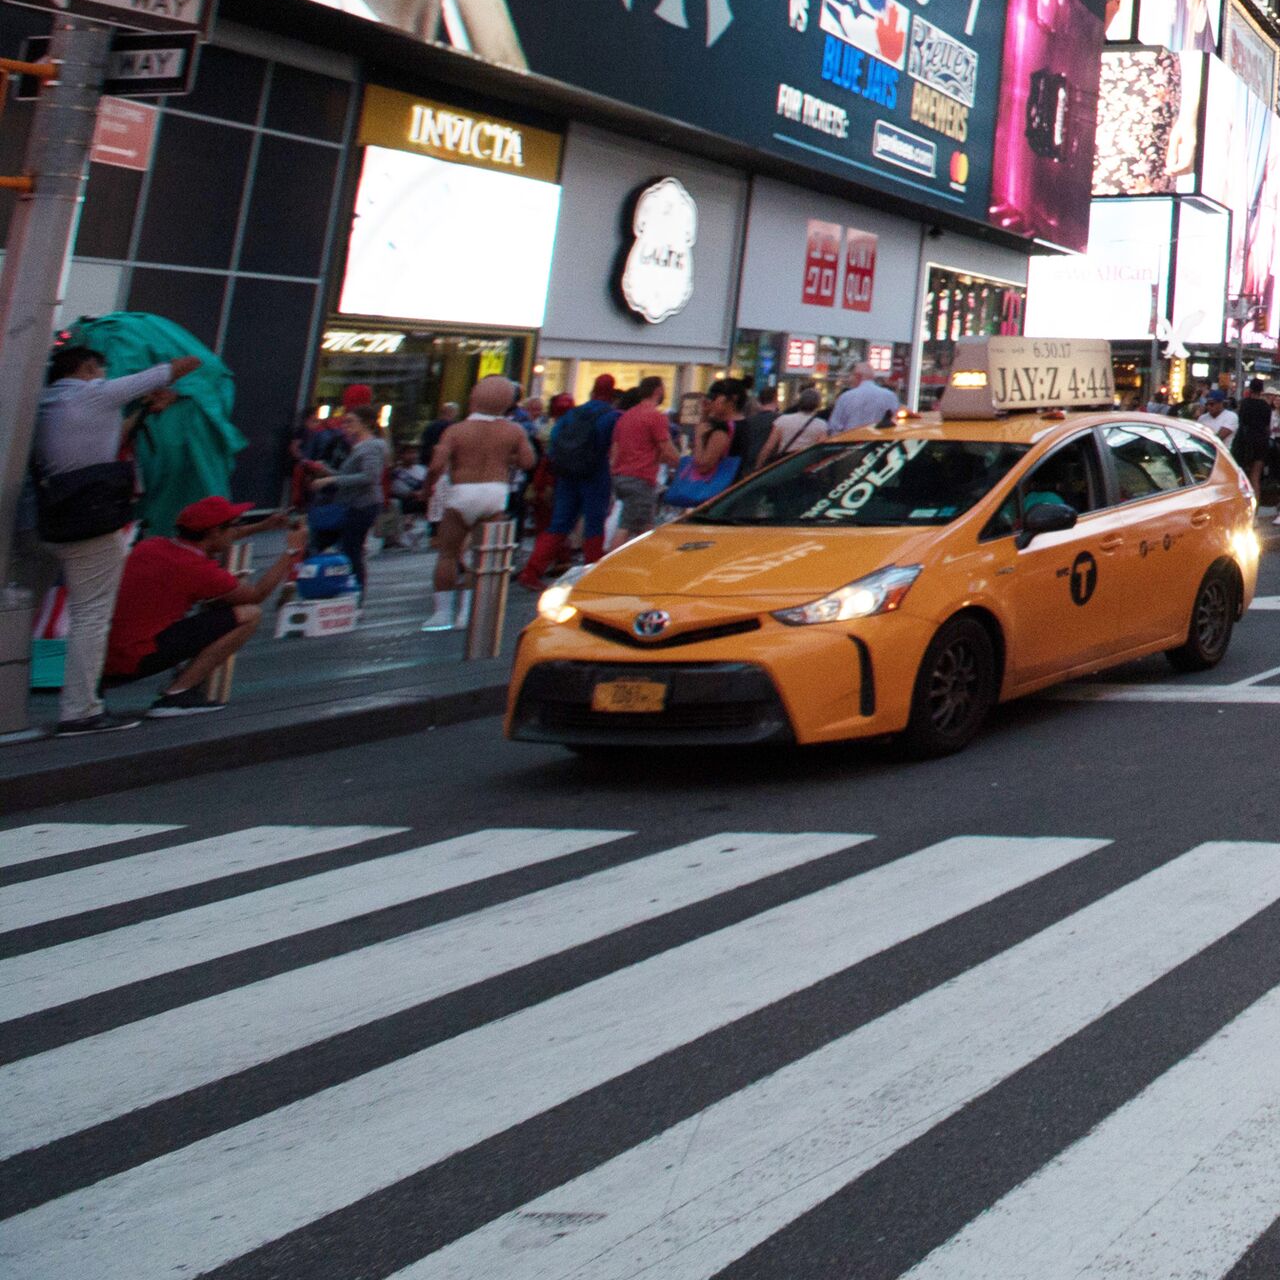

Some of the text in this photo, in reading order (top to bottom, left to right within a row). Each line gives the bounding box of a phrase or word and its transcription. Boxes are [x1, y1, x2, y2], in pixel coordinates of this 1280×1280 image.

[821, 34, 864, 94] BLUE
[408, 104, 526, 168] INVICTA
[1033, 342, 1071, 359] 6.30.17
[995, 367, 1060, 402] JAY:Z
[1067, 367, 1111, 400] 4:44
